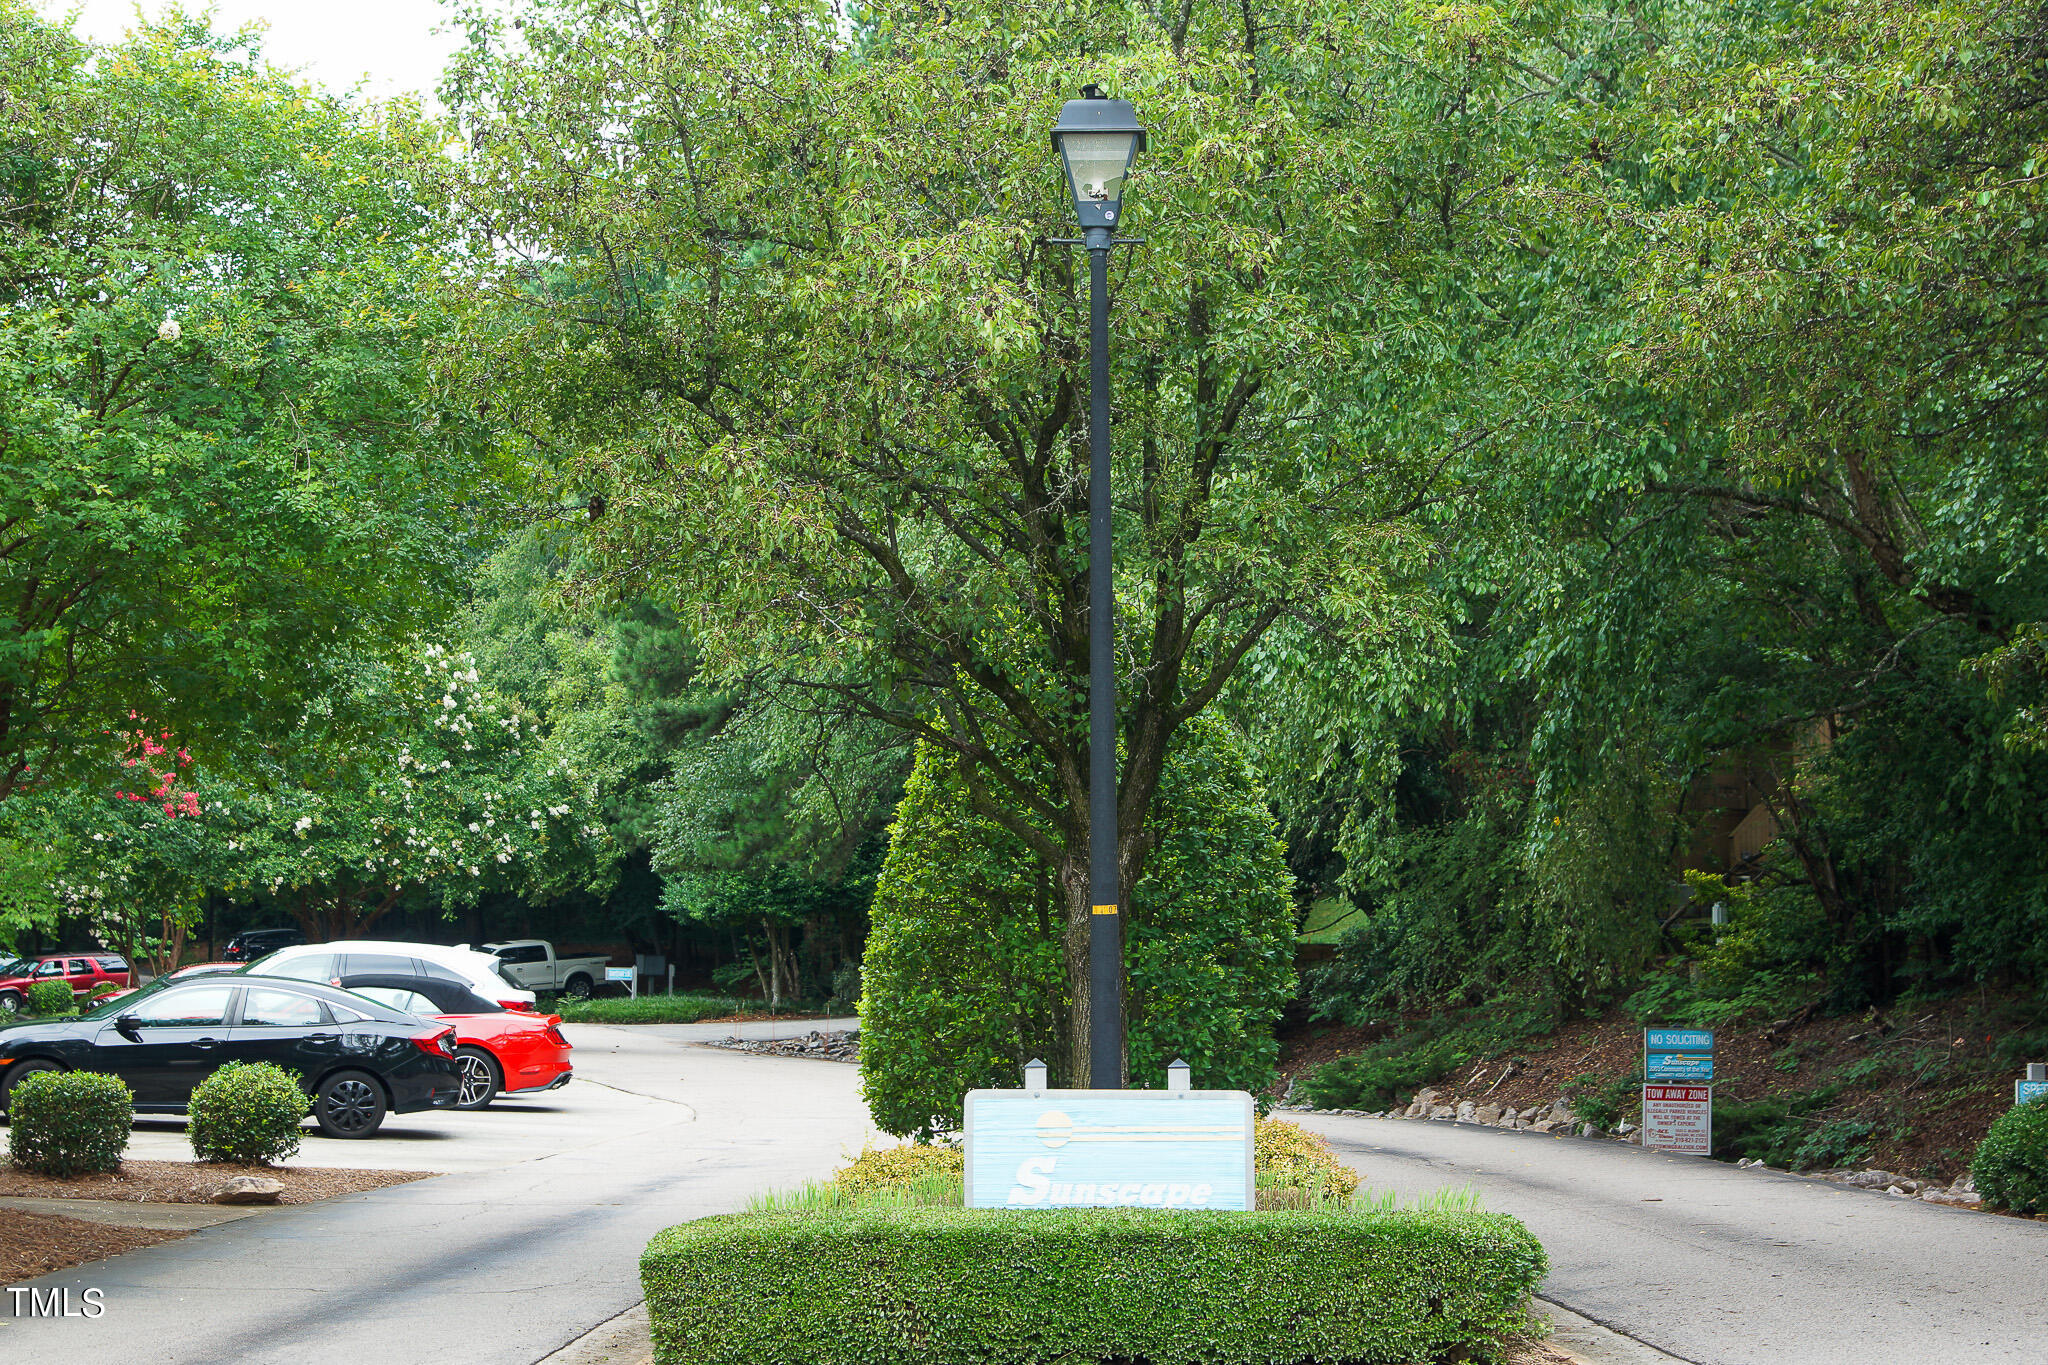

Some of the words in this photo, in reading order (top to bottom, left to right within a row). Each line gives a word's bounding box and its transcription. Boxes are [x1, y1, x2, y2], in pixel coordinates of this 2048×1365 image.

[1650, 1034, 1663, 1045] NO
[1666, 1034, 1710, 1045] SOLICITING
[1647, 1088, 1663, 1099] TOW
[1665, 1088, 1686, 1099] AWAY
[1688, 1090, 1708, 1100] ZONE
[1007, 1157, 1214, 1206] Sunscape
